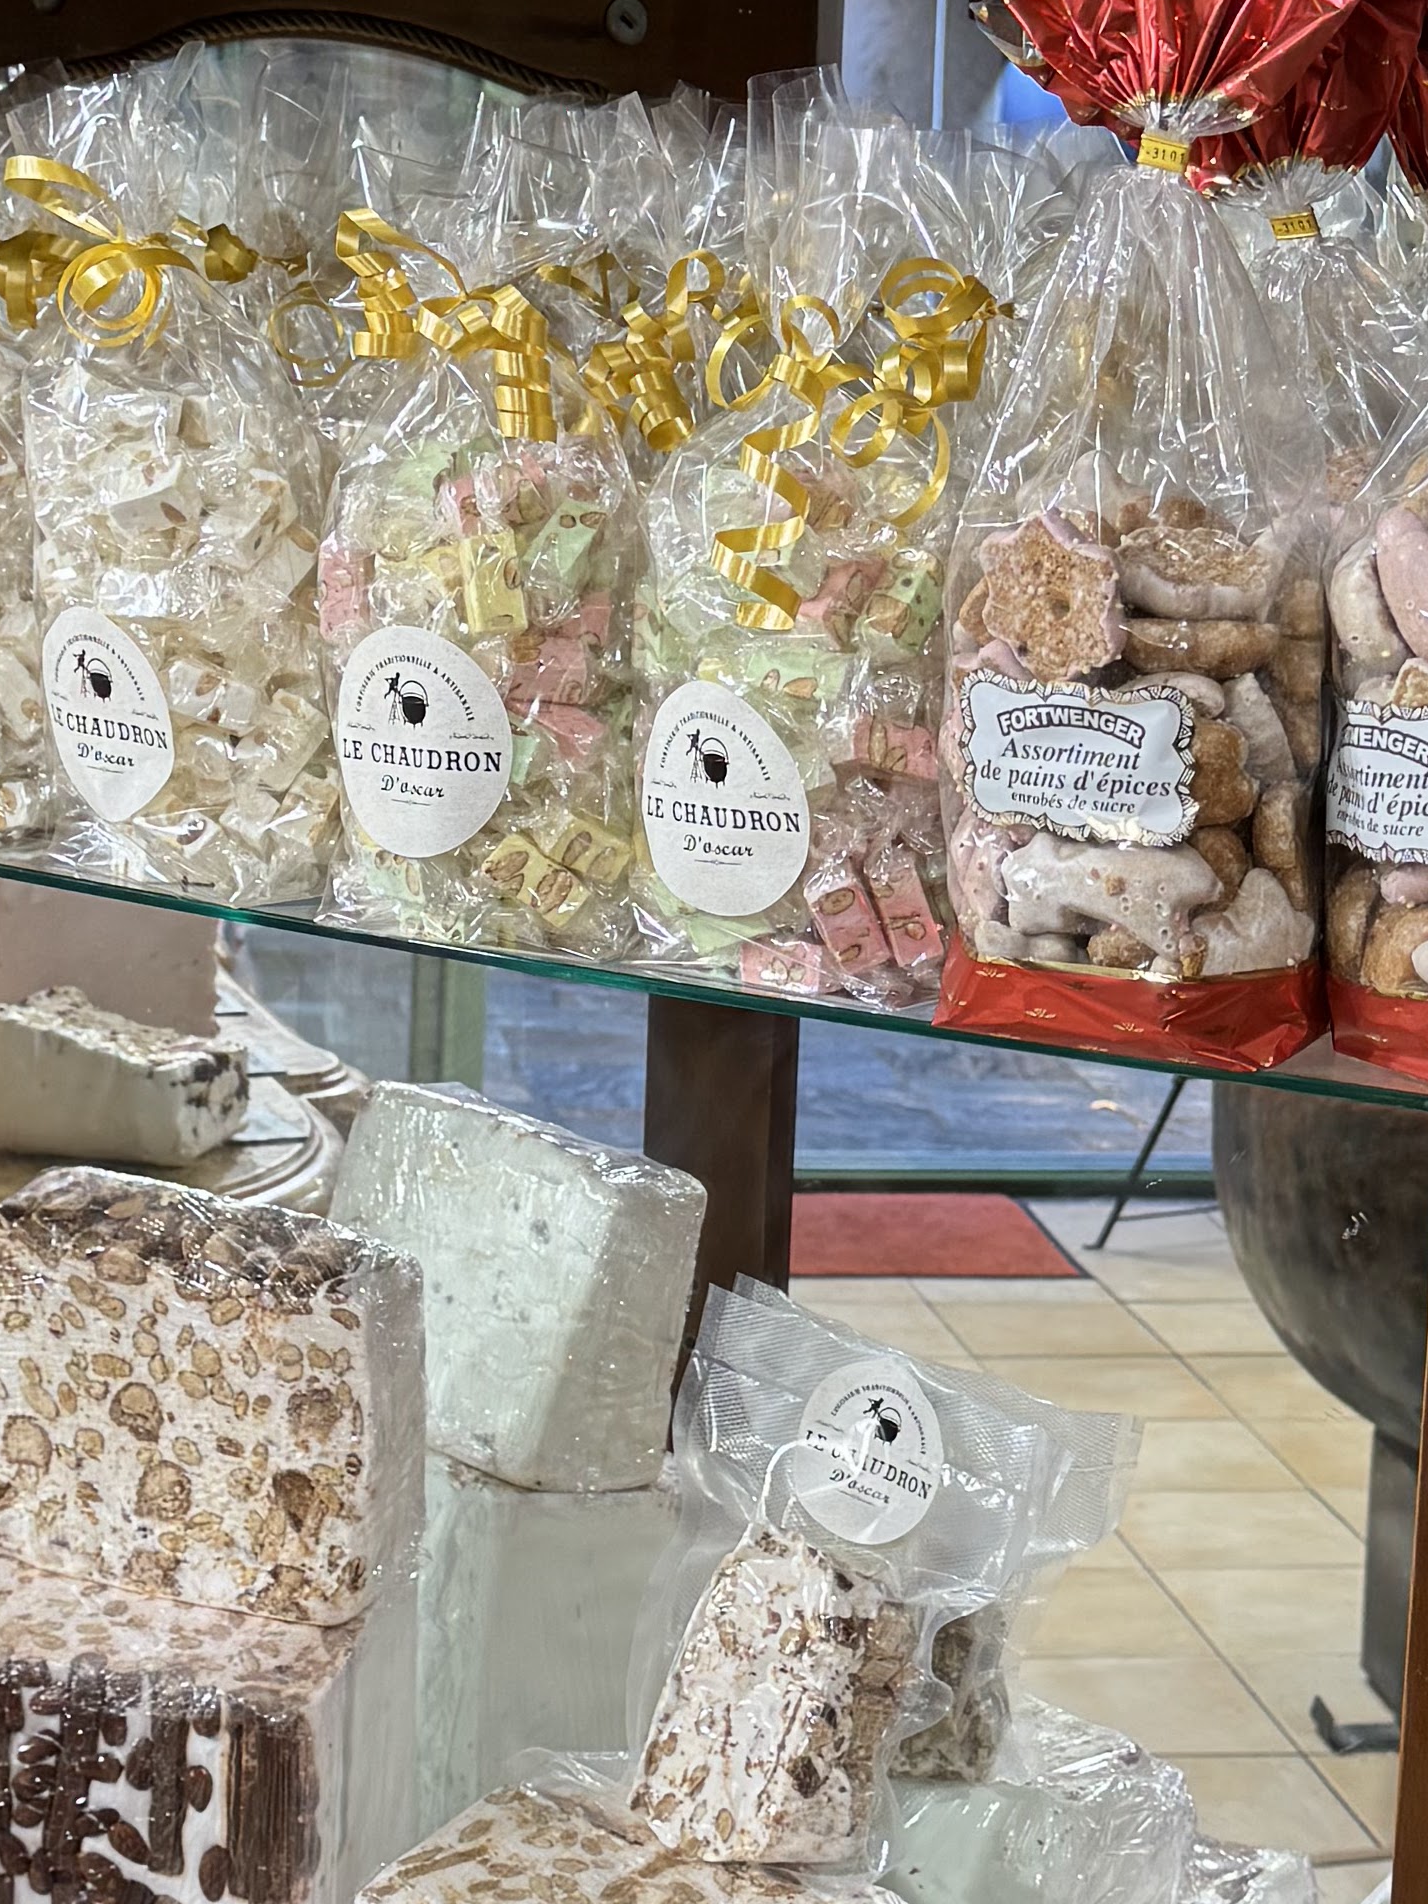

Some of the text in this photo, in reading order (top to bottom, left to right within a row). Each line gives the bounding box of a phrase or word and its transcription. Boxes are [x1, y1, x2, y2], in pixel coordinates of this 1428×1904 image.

[67, 713, 168, 749] CHAUDRON
[998, 705, 1145, 748] FORTWENGER
[343, 738, 502, 772] LE CHAUDRON
[1001, 738, 1141, 771] Assortiment
[981, 759, 1172, 799] de pains d'épices
[647, 795, 801, 833] LE CHAUDRON
[1011, 790, 1135, 814] enrobés de sucre
[683, 834, 754, 857] D'oscar
[1383, 824, 1424, 836] sucre
